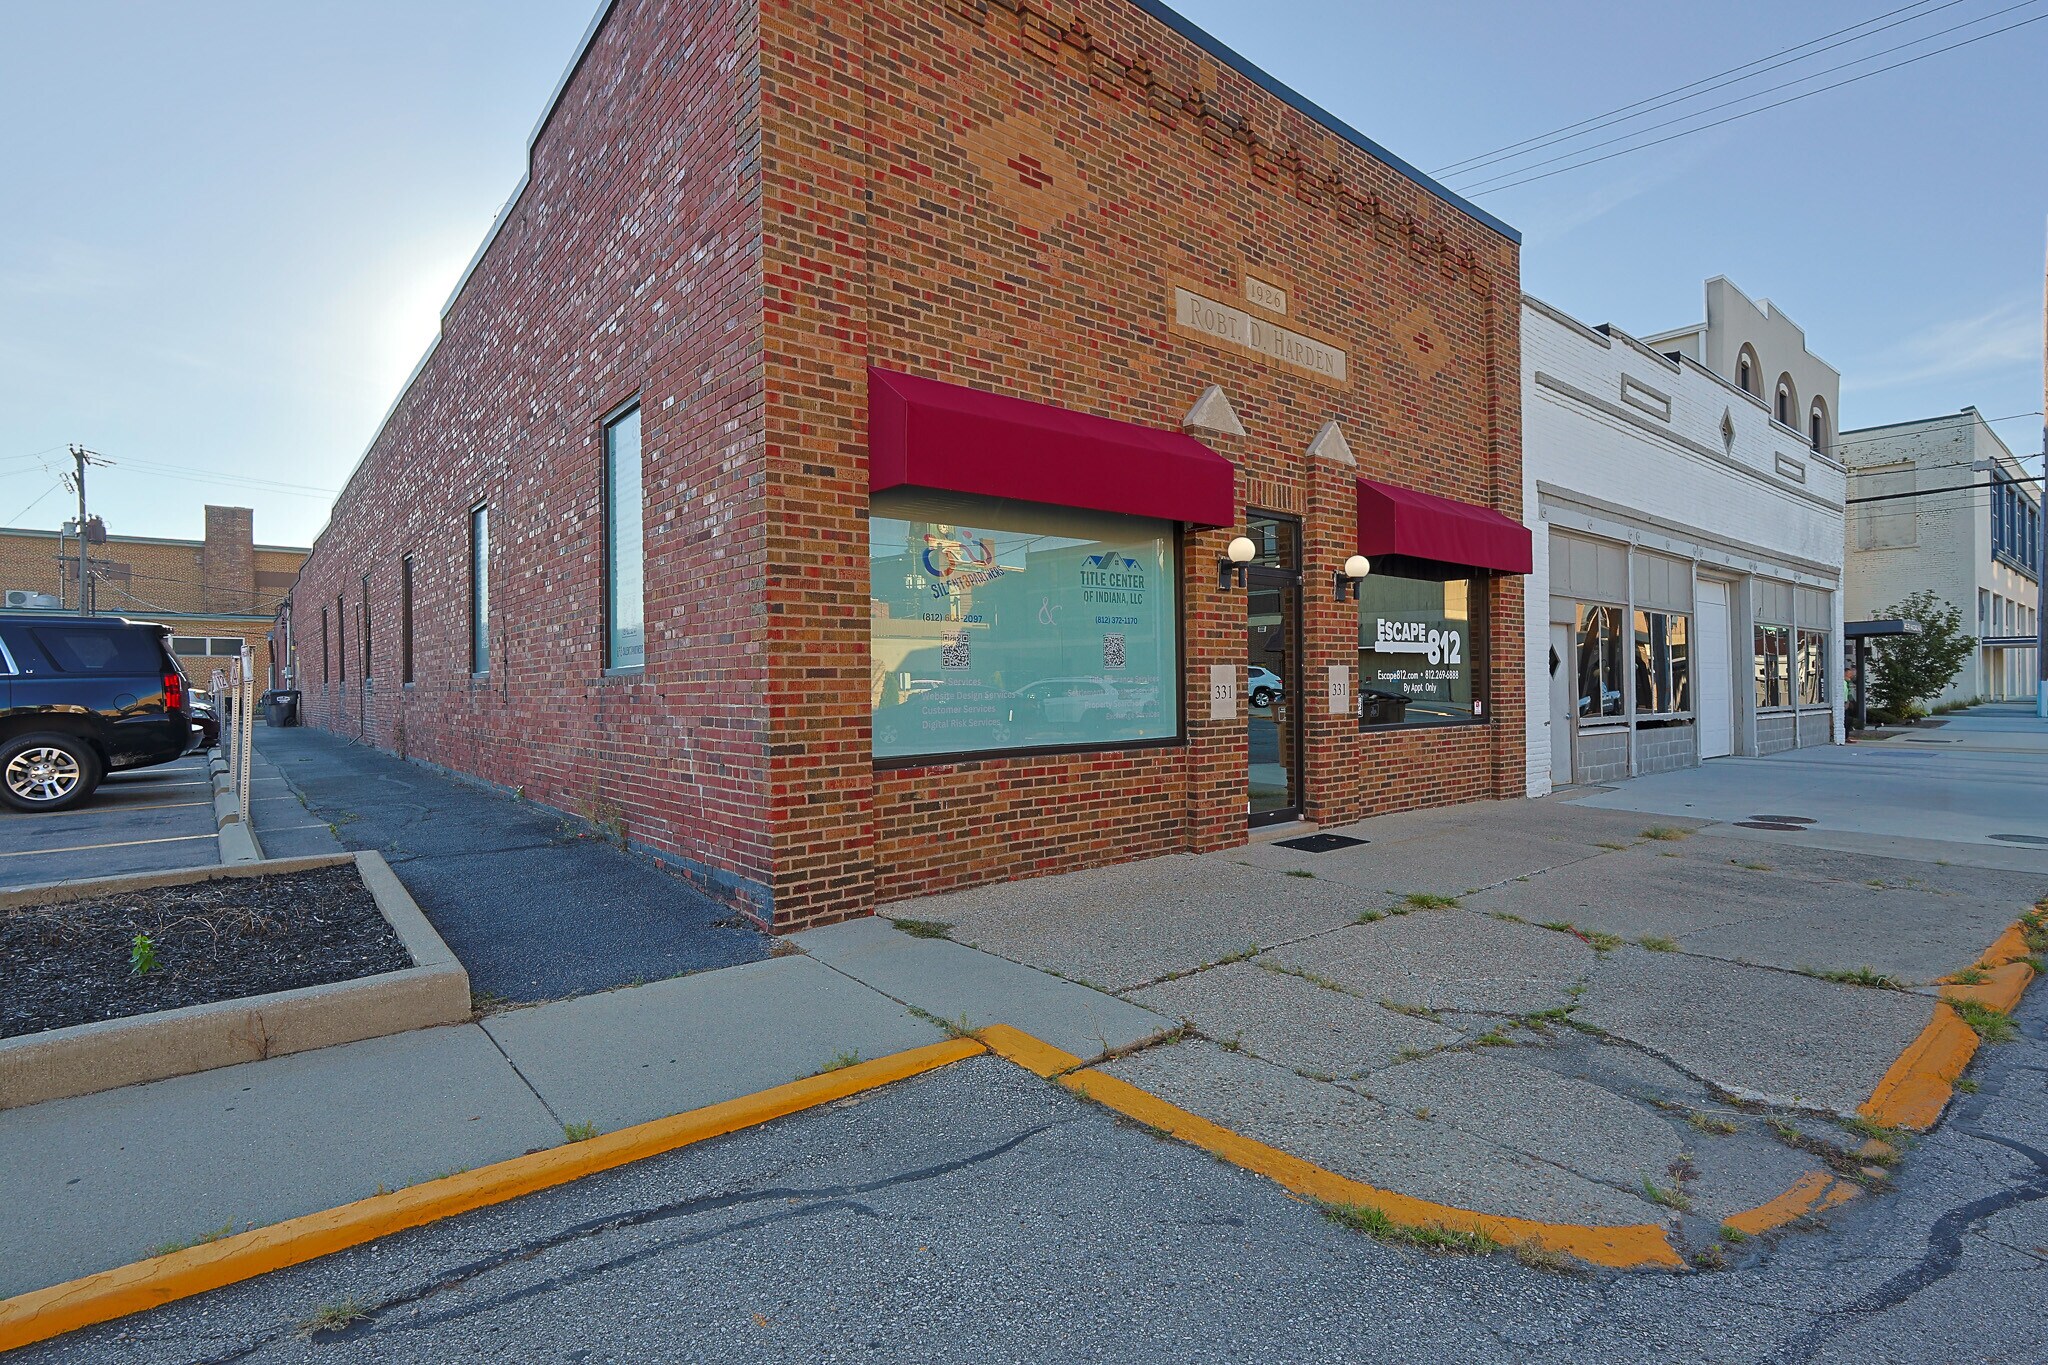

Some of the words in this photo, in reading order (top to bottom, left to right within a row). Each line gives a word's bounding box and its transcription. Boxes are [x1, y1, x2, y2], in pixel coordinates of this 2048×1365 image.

[1250, 283, 1281, 308] 1926
[1190, 297, 1241, 341] ROBT.
[1251, 321, 1267, 350] D.
[1273, 329, 1335, 375] HARDEN
[1080, 570, 1106, 587] TITLE
[1109, 572, 1145, 589] CENTER
[1083, 590, 1094, 602] OF
[1096, 591, 1129, 606] INDIANA,
[1130, 593, 1143, 605] LLC
[922, 613, 943, 623] (812)
[1038, 597, 1063, 626] &
[1095, 616, 1111, 624] (812)
[1111, 616, 1138, 625] 372-1170
[1427, 629, 1461, 665] 812
[1377, 669, 1419, 683] Escape812.com
[1214, 685, 1232, 700] 331
[1332, 683, 1346, 696] 331
[1403, 683, 1411, 694] By
[1425, 683, 1437, 694] Only
[956, 691, 983, 702] Design
[922, 706, 961, 715] Customer
[963, 704, 997, 713] Services
[922, 720, 949, 731] Digital
[951, 719, 967, 728] Risk
[968, 717, 1001, 727] Services
